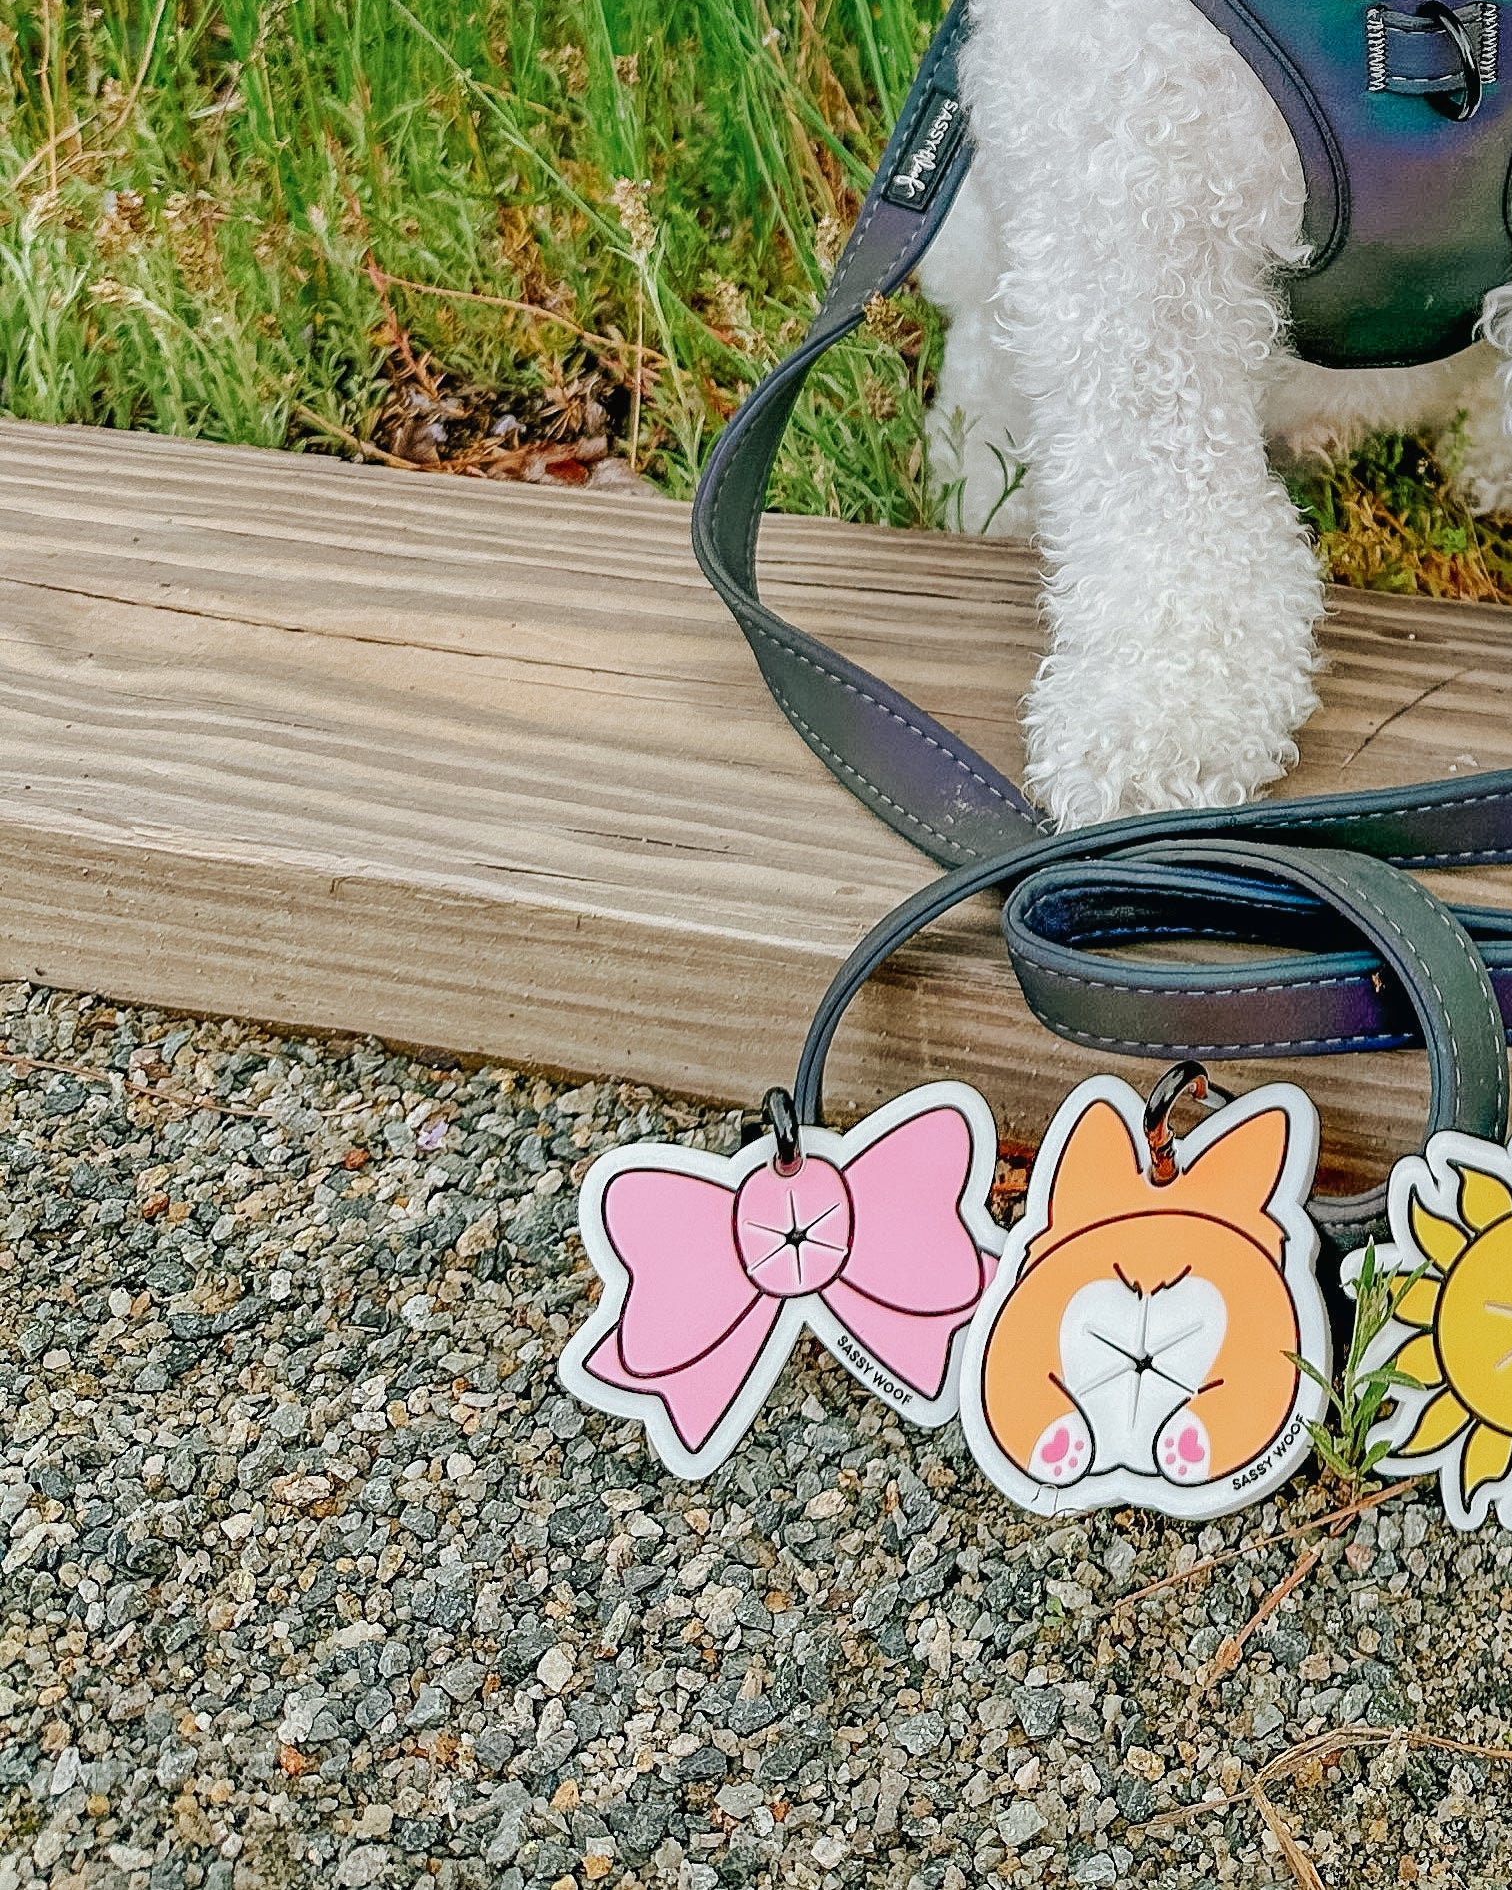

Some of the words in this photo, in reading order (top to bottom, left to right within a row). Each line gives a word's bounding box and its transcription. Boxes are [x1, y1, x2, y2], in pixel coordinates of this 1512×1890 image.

[924, 98, 959, 154] SASSY
[837, 1335, 874, 1375] SASSY
[872, 1371, 914, 1405] WOOF
[1232, 1455, 1273, 1490] SASSY
[1272, 1412, 1304, 1458] WOOF
